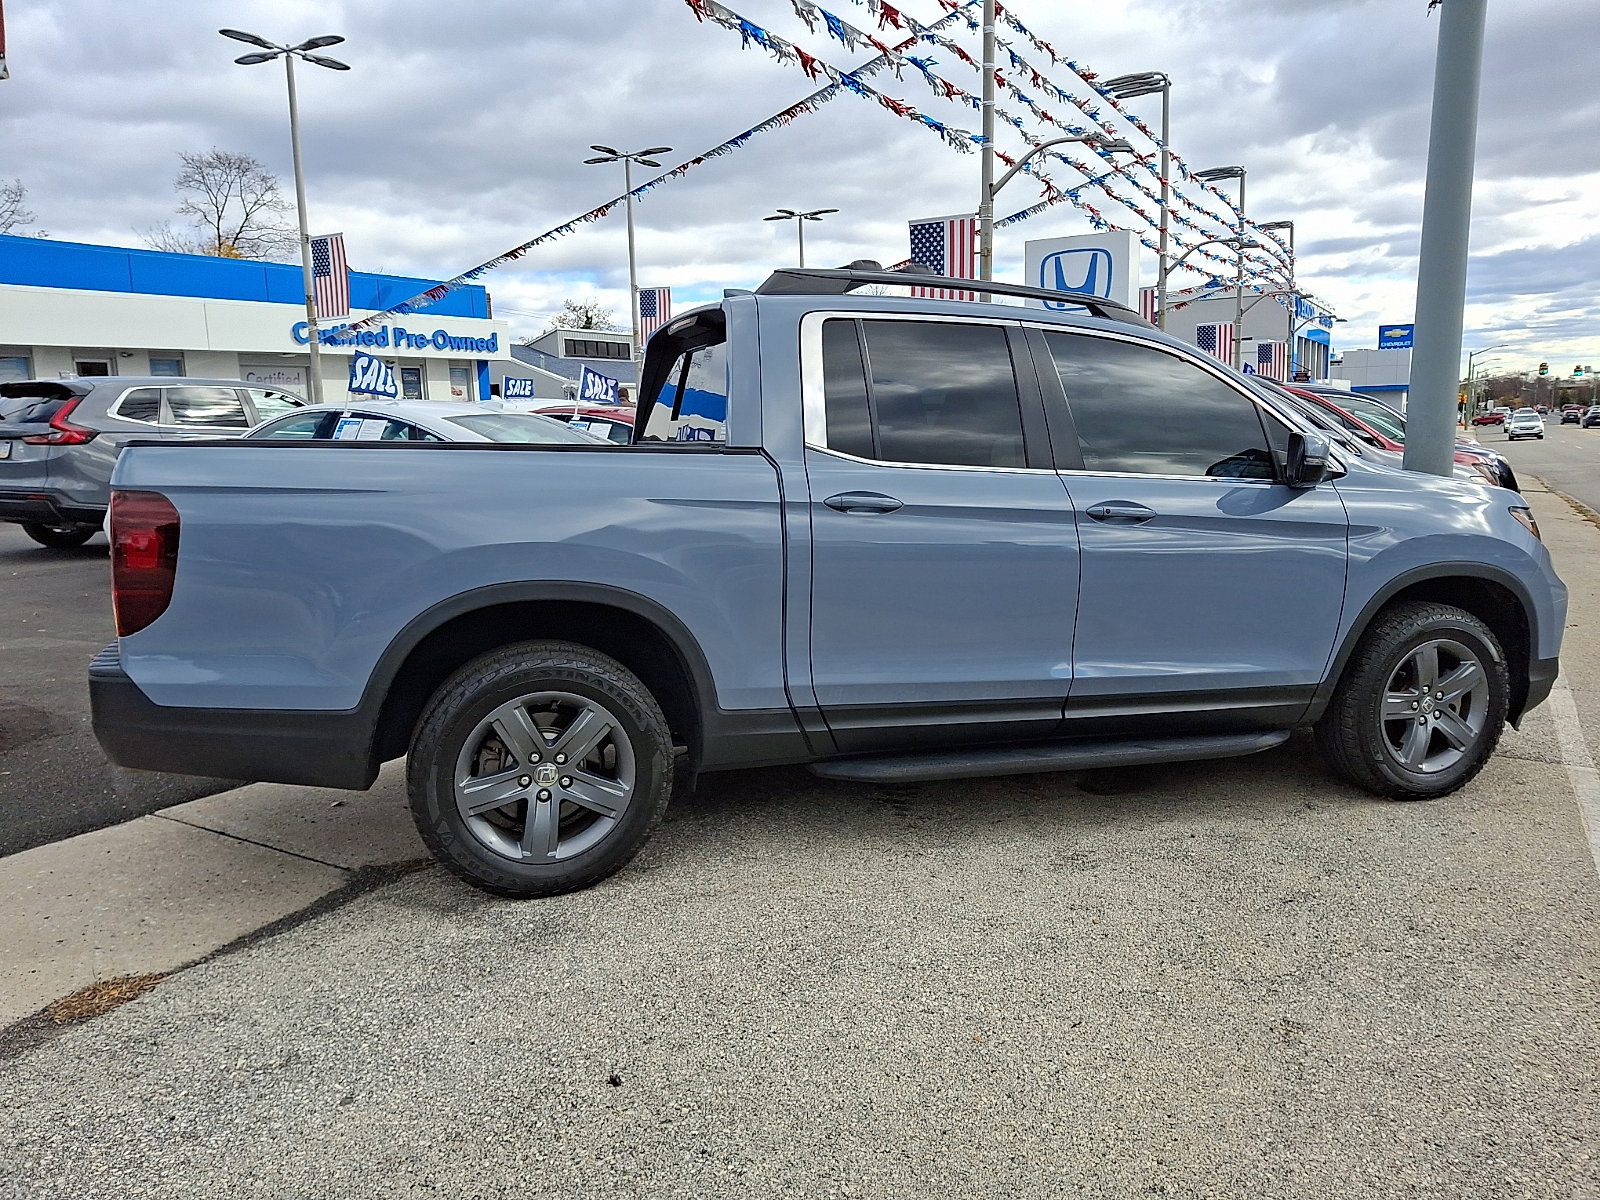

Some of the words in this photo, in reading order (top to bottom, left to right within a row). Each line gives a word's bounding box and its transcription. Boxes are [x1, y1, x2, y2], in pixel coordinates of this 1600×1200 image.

[393, 327, 498, 351] Pre-Owned
[246, 371, 300, 385] Certified
[506, 379, 532, 396] SALE
[585, 372, 617, 402] SALE
